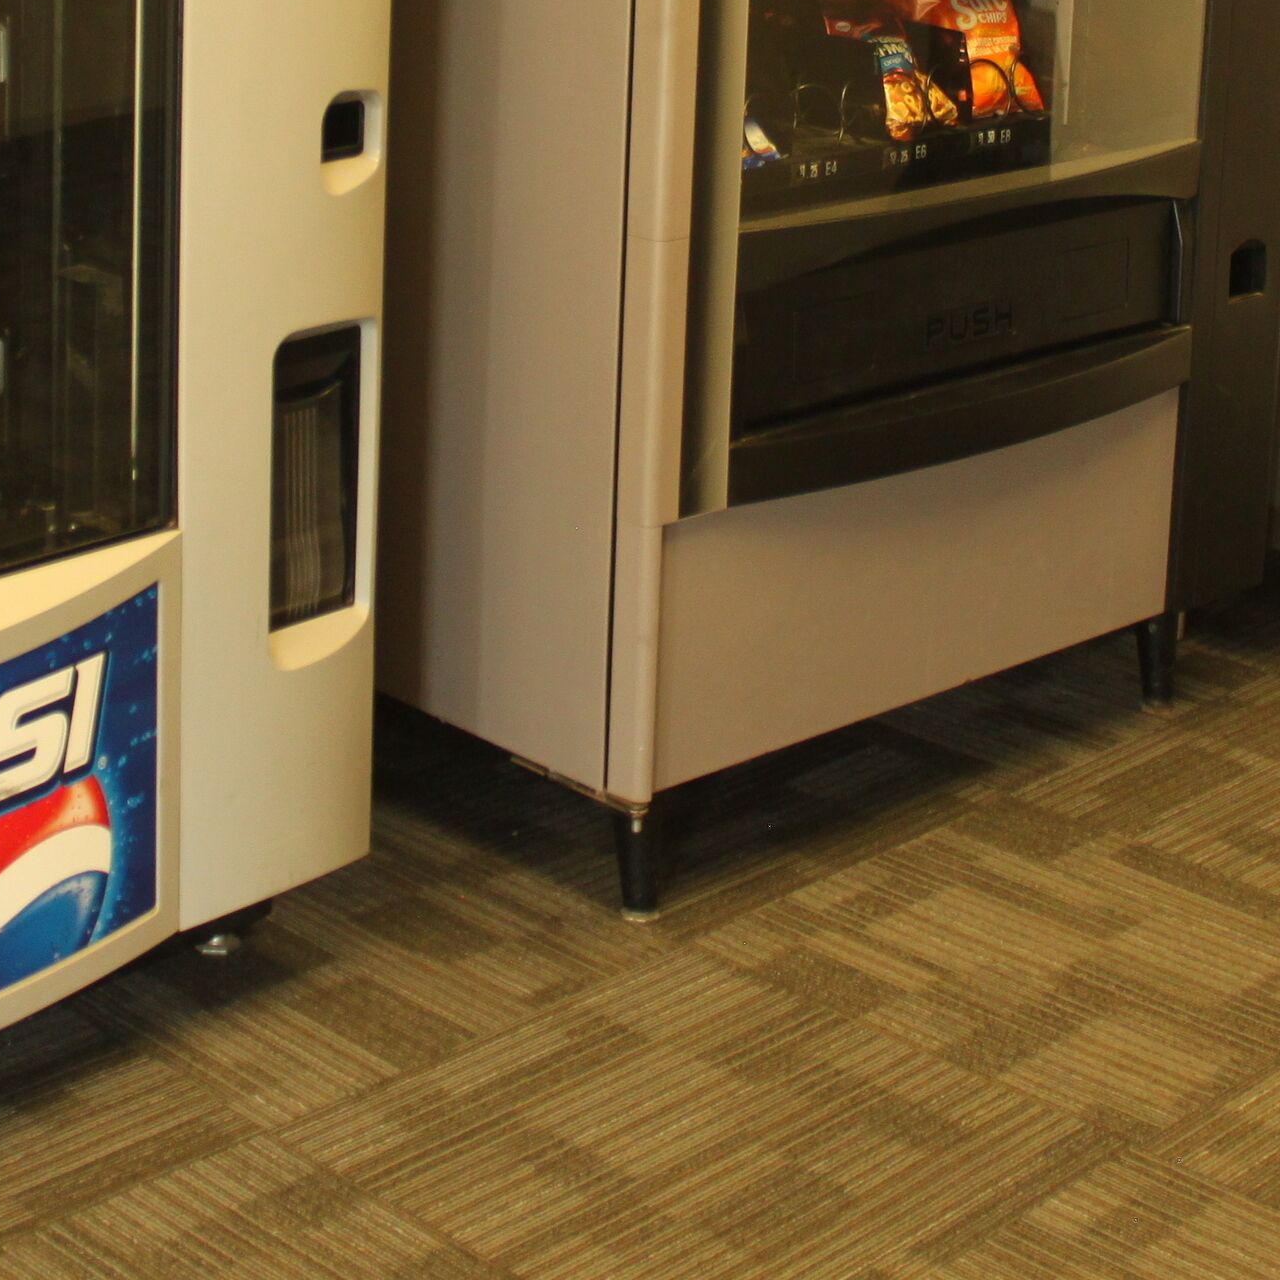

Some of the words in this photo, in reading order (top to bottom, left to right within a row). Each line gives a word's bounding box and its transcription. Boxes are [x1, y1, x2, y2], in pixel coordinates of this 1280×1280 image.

[977, 11, 1008, 24] CHIPS
[1000, 128, 1011, 144] E8
[915, 144, 927, 160] E6
[825, 160, 838, 176] E4
[925, 302, 1014, 345] PUSH
